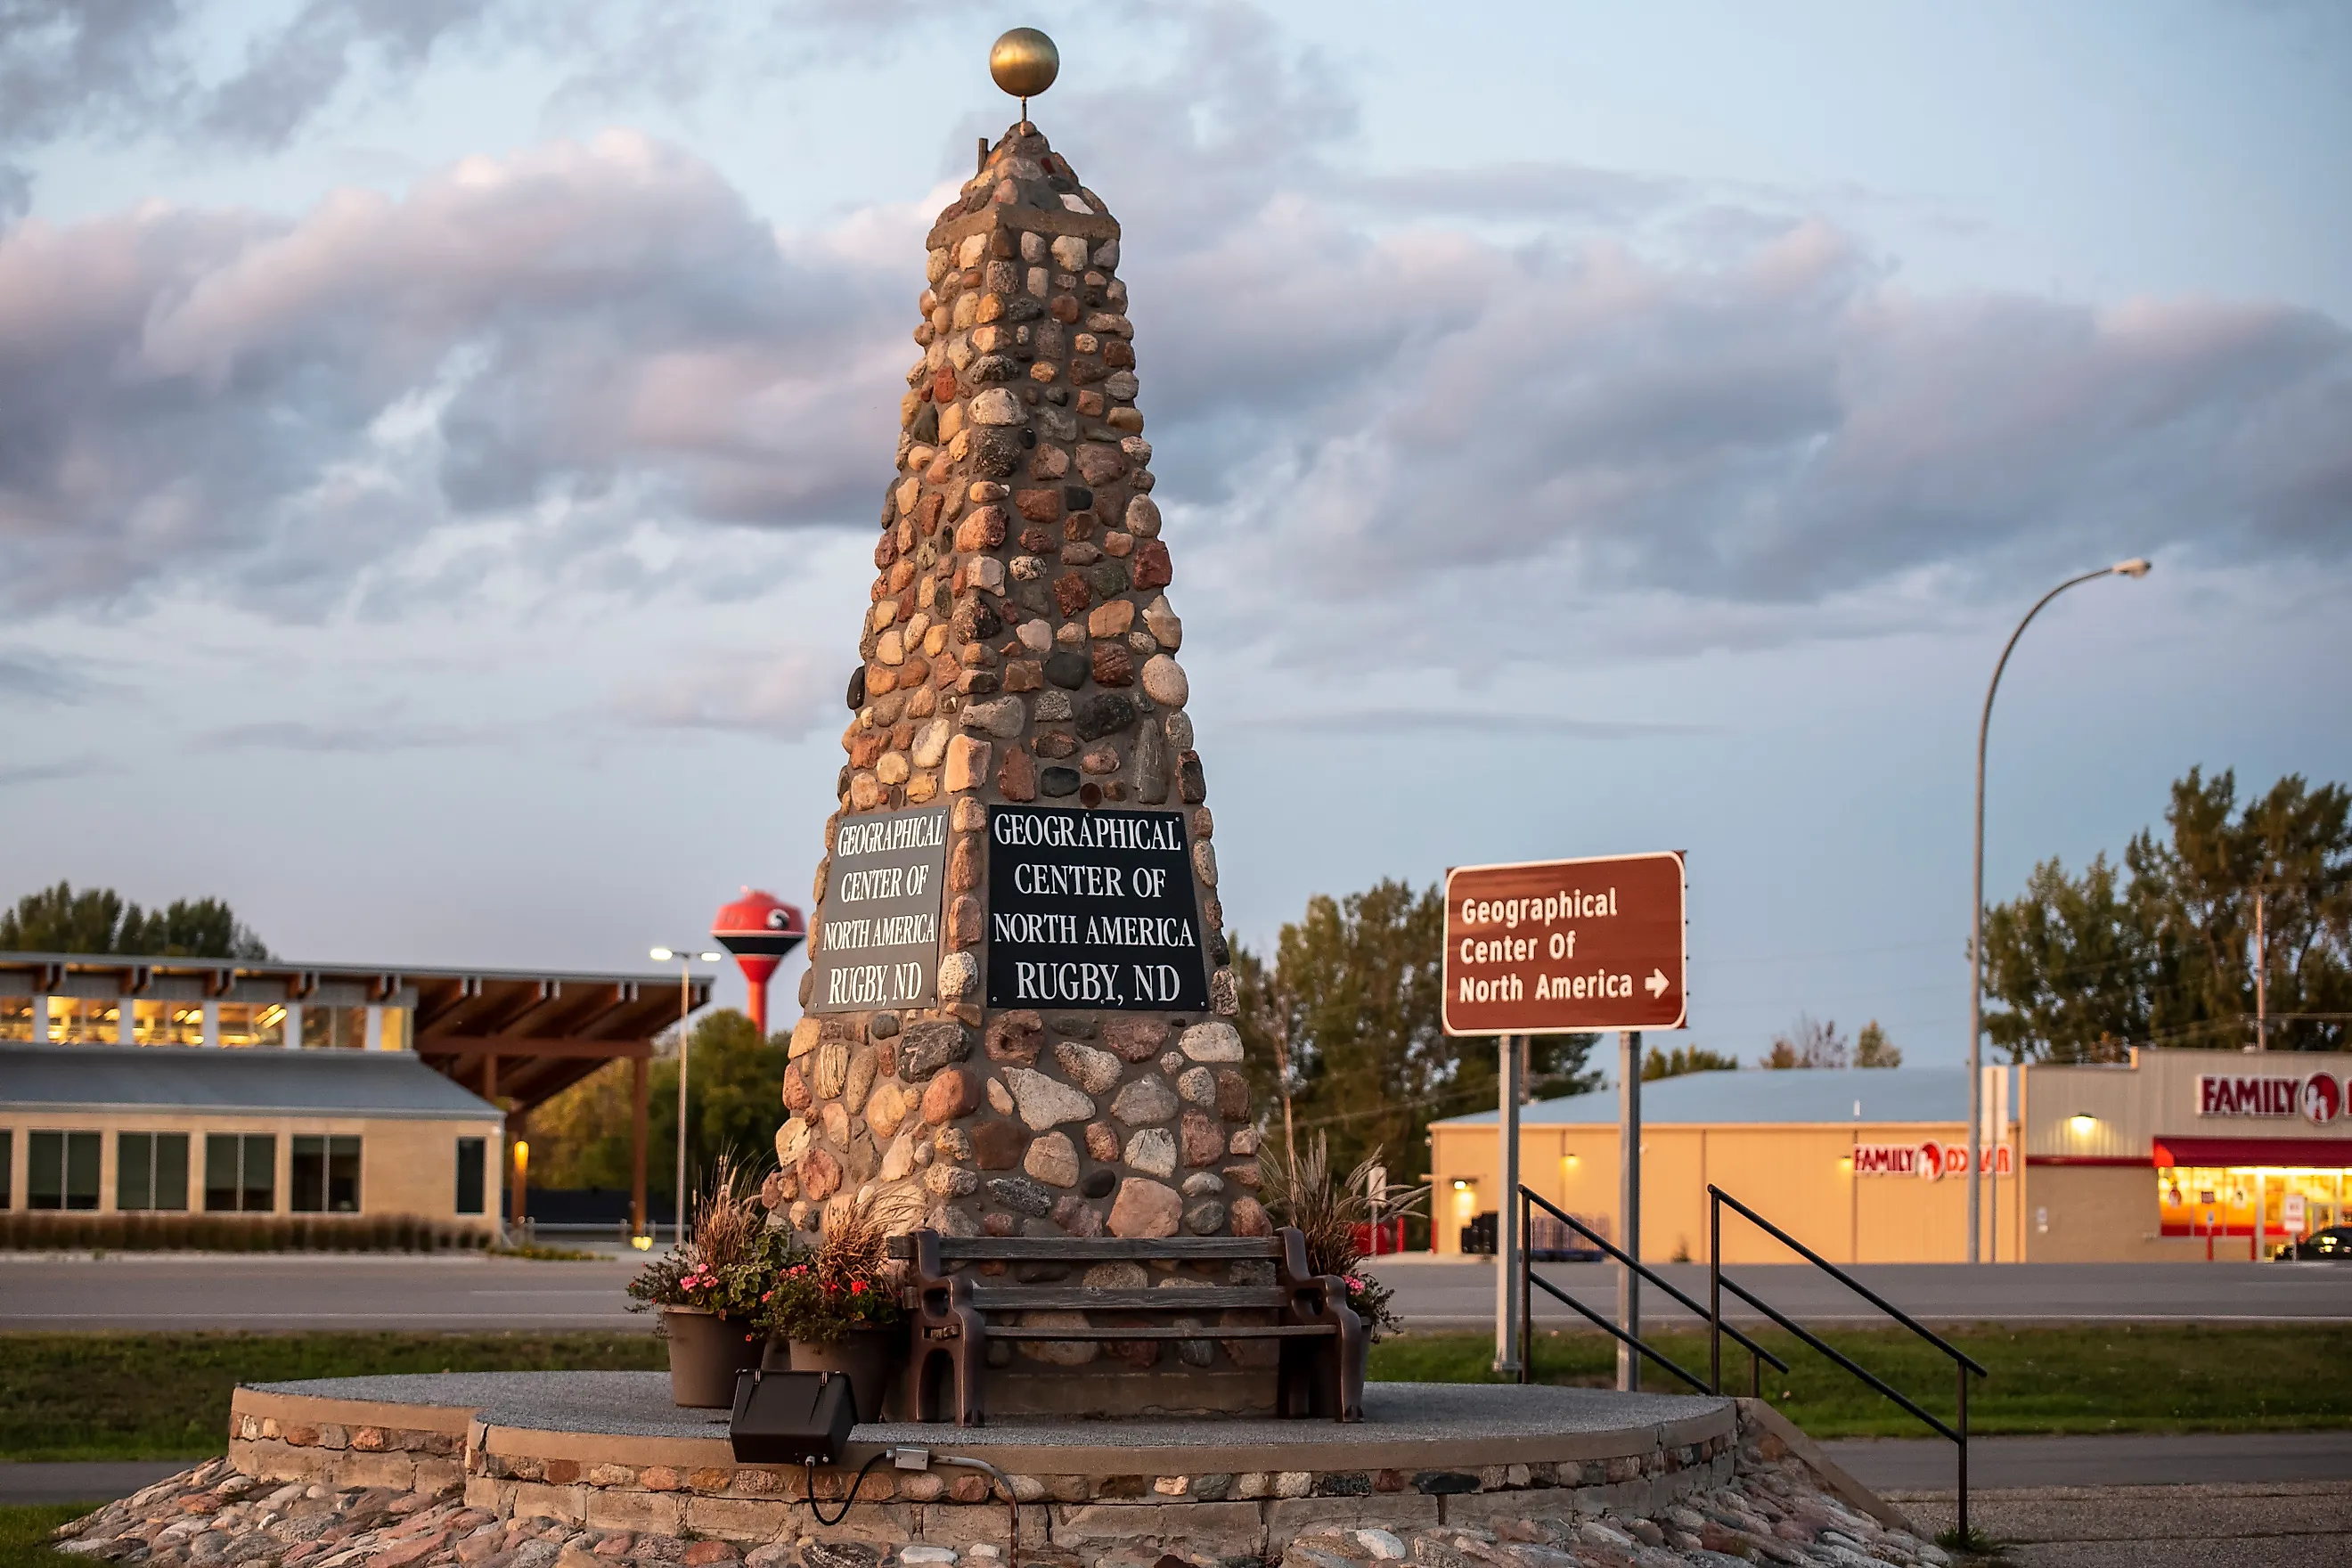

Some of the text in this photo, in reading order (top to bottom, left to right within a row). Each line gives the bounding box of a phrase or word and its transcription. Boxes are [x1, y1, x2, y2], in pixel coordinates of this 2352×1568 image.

[837, 814, 943, 857] GEOGRAPHICAL
[994, 813, 1181, 851] GEOGRAPHICAL
[841, 865, 929, 902] CENTER OF
[1014, 863, 1166, 898] CENTER OF
[1461, 886, 1618, 929] Geographical
[822, 913, 935, 951] NORTH AMERICA
[993, 912, 1196, 947] NORTH AMERICA
[1459, 929, 1577, 965] Center Of
[828, 961, 922, 1006] RUGBY, ND
[1016, 961, 1180, 1006] RUGBY, ND
[1459, 968, 1633, 1003] North America
[2202, 1076, 2299, 1114] FAMILY
[1855, 1148, 1915, 1172] FAMILY
